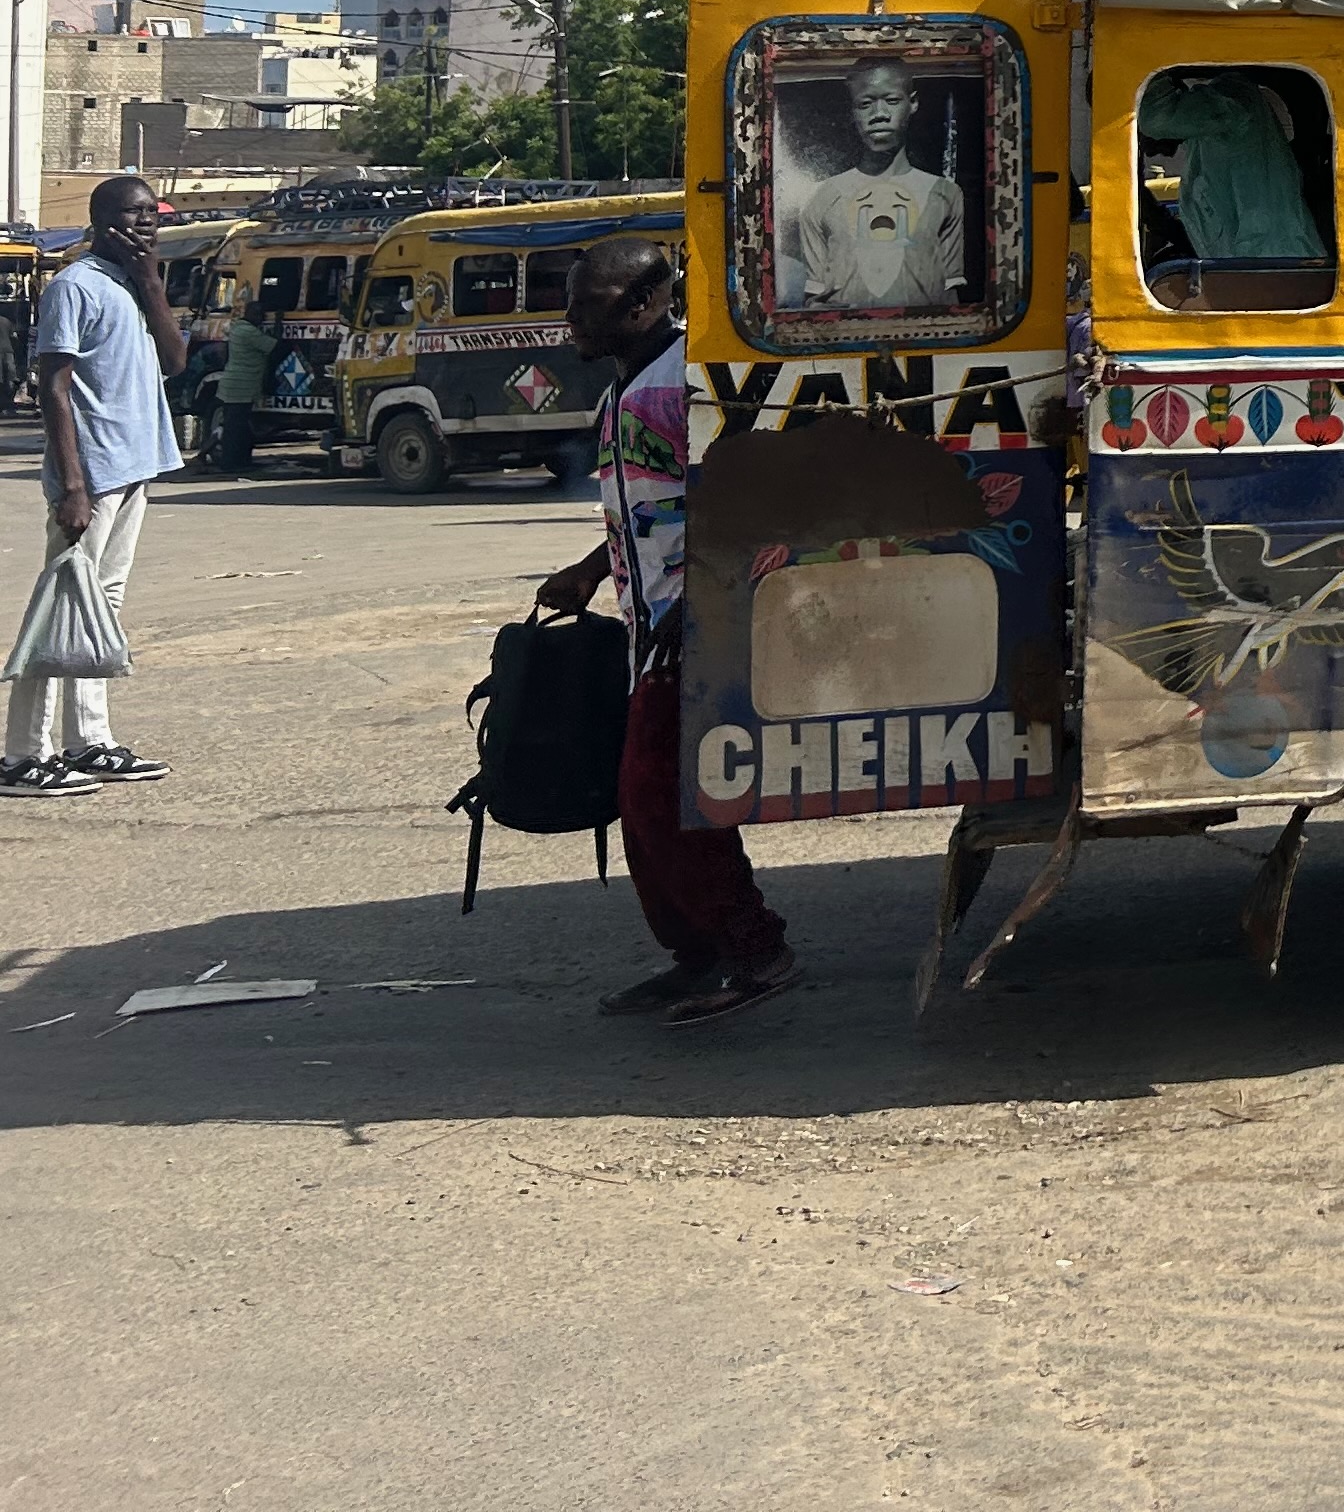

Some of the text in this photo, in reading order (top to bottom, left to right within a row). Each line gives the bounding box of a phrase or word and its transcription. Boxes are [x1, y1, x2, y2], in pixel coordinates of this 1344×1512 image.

[449, 329, 546, 349] TRANSPORT
[702, 355, 1029, 449] YANA
[699, 710, 1054, 813] CHEIKH
